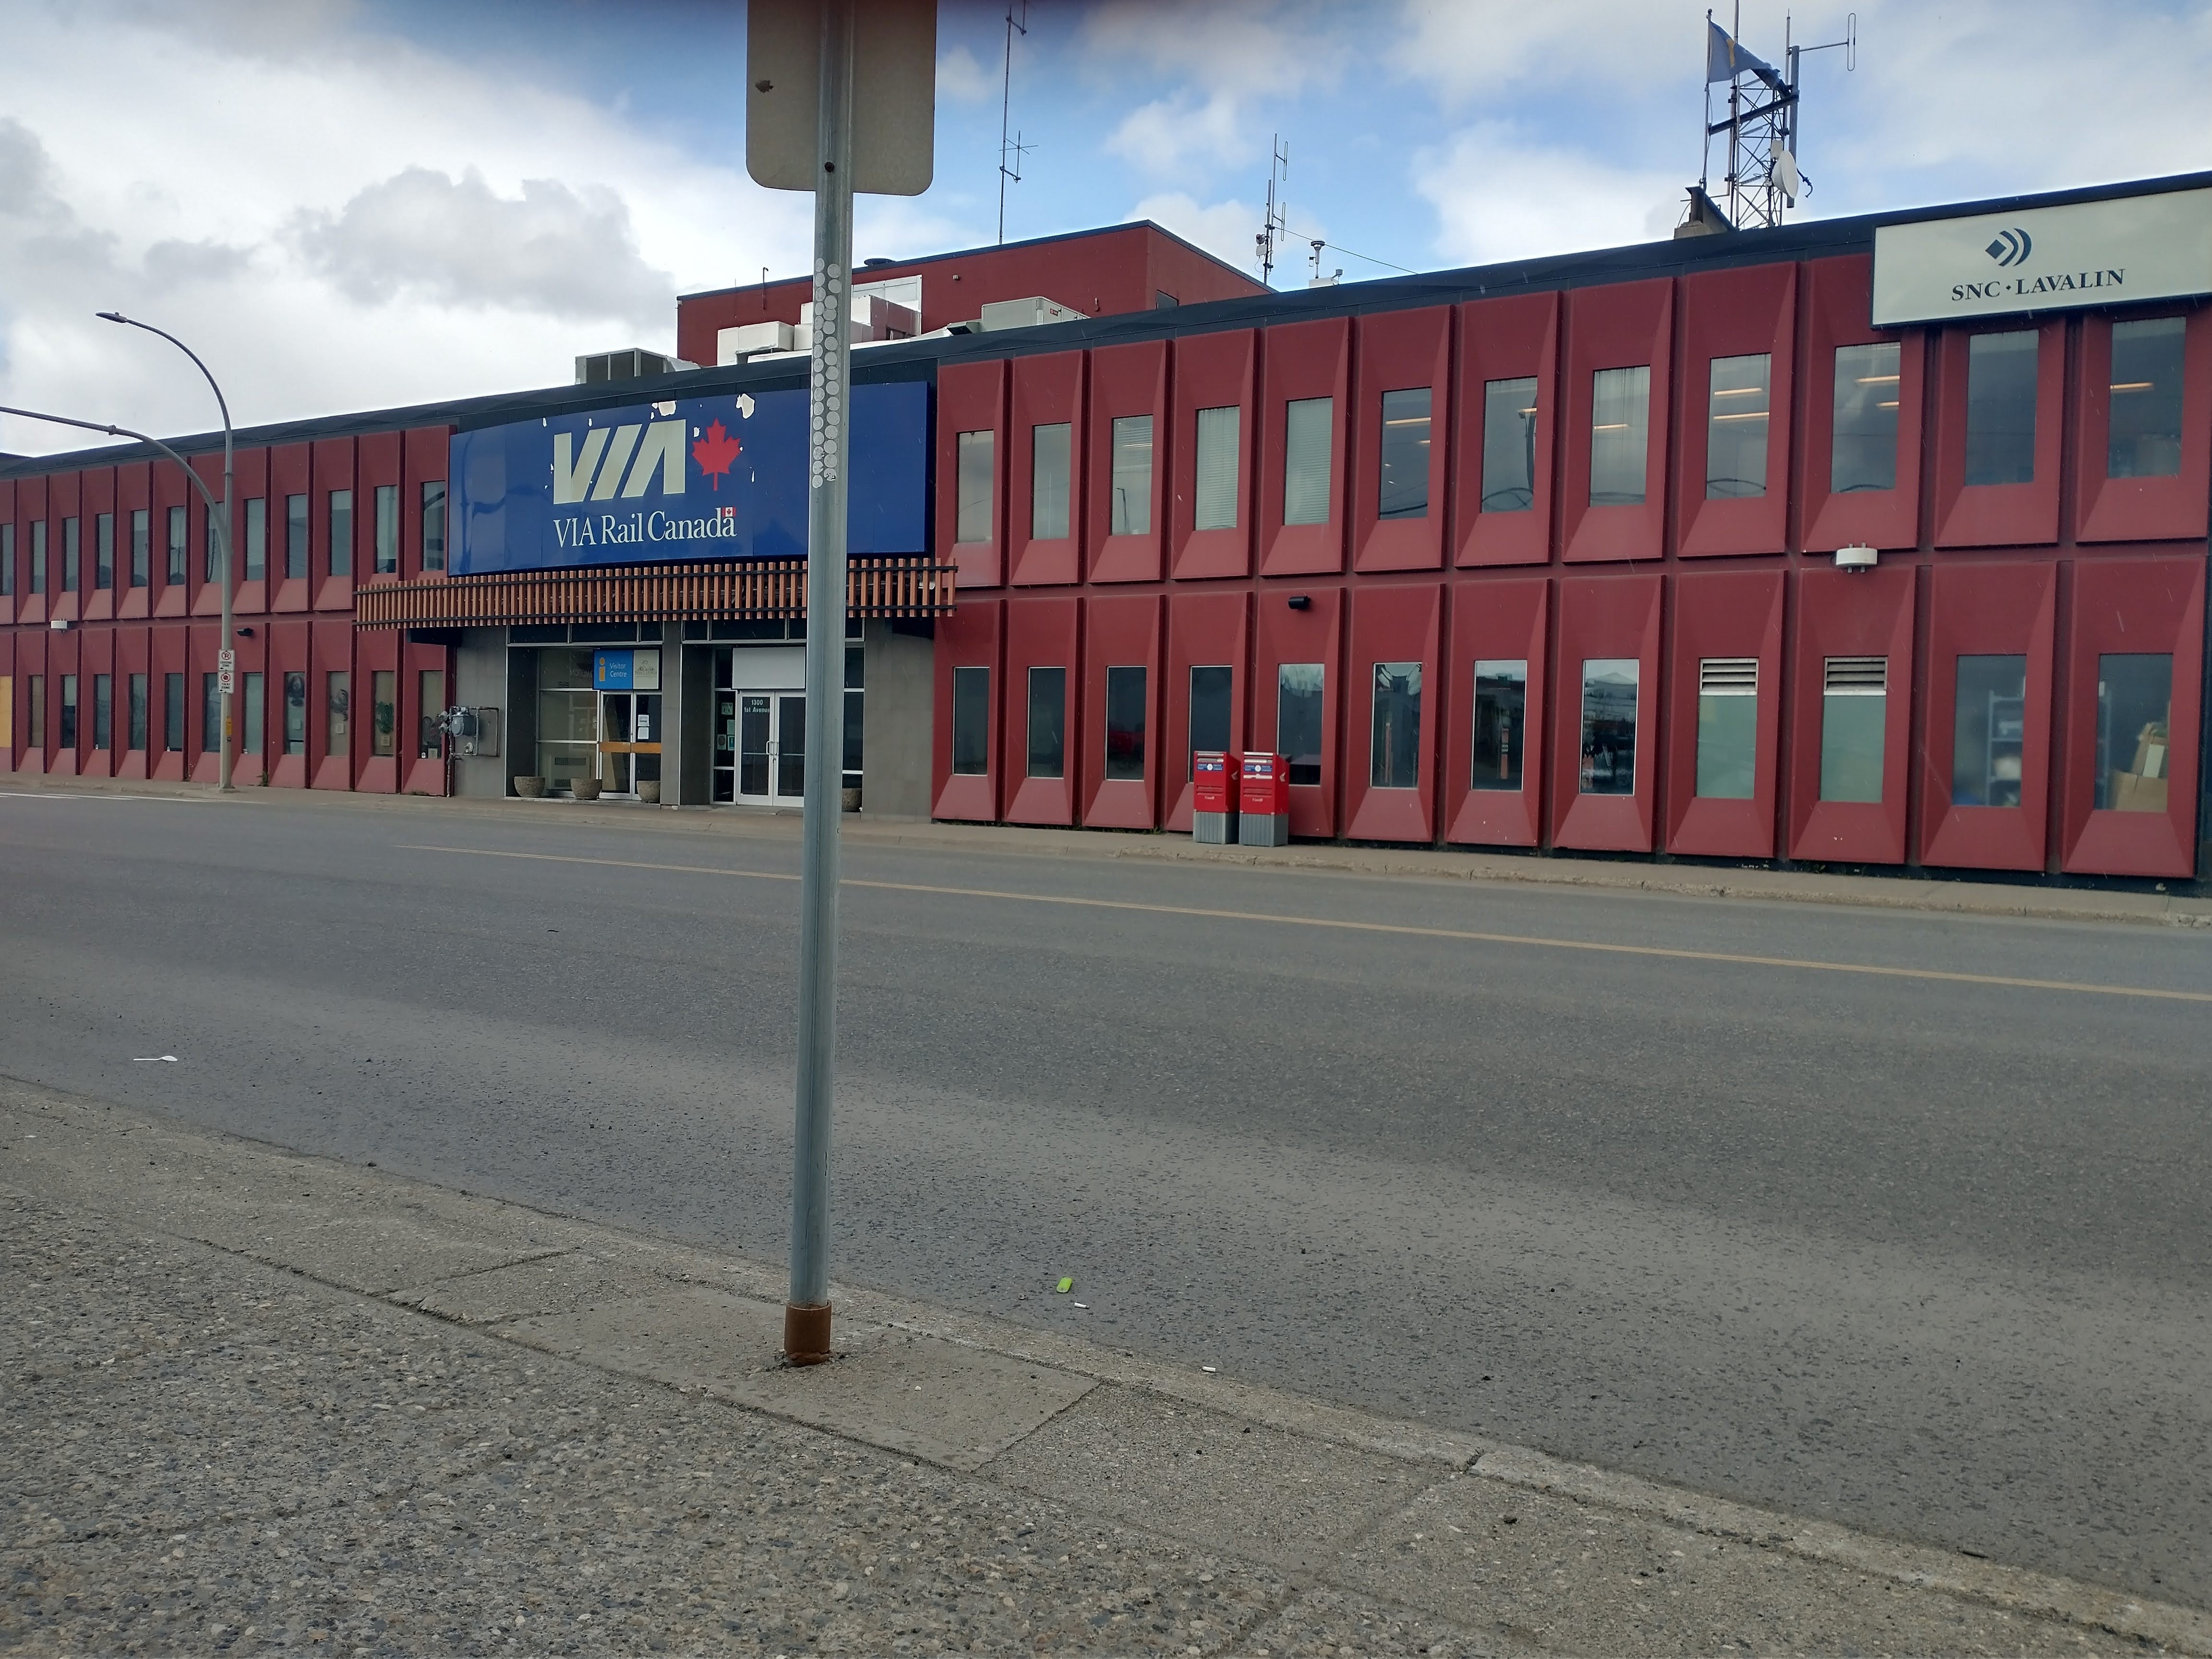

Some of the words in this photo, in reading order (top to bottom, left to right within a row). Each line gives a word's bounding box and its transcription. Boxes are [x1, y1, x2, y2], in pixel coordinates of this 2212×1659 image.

[1951, 281, 2001, 301] SNC
[2015, 268, 2126, 295] LAVALIN
[553, 419, 686, 505] VIA
[553, 517, 597, 548] VIA
[601, 512, 644, 545] Rail
[647, 507, 737, 541] Canada
